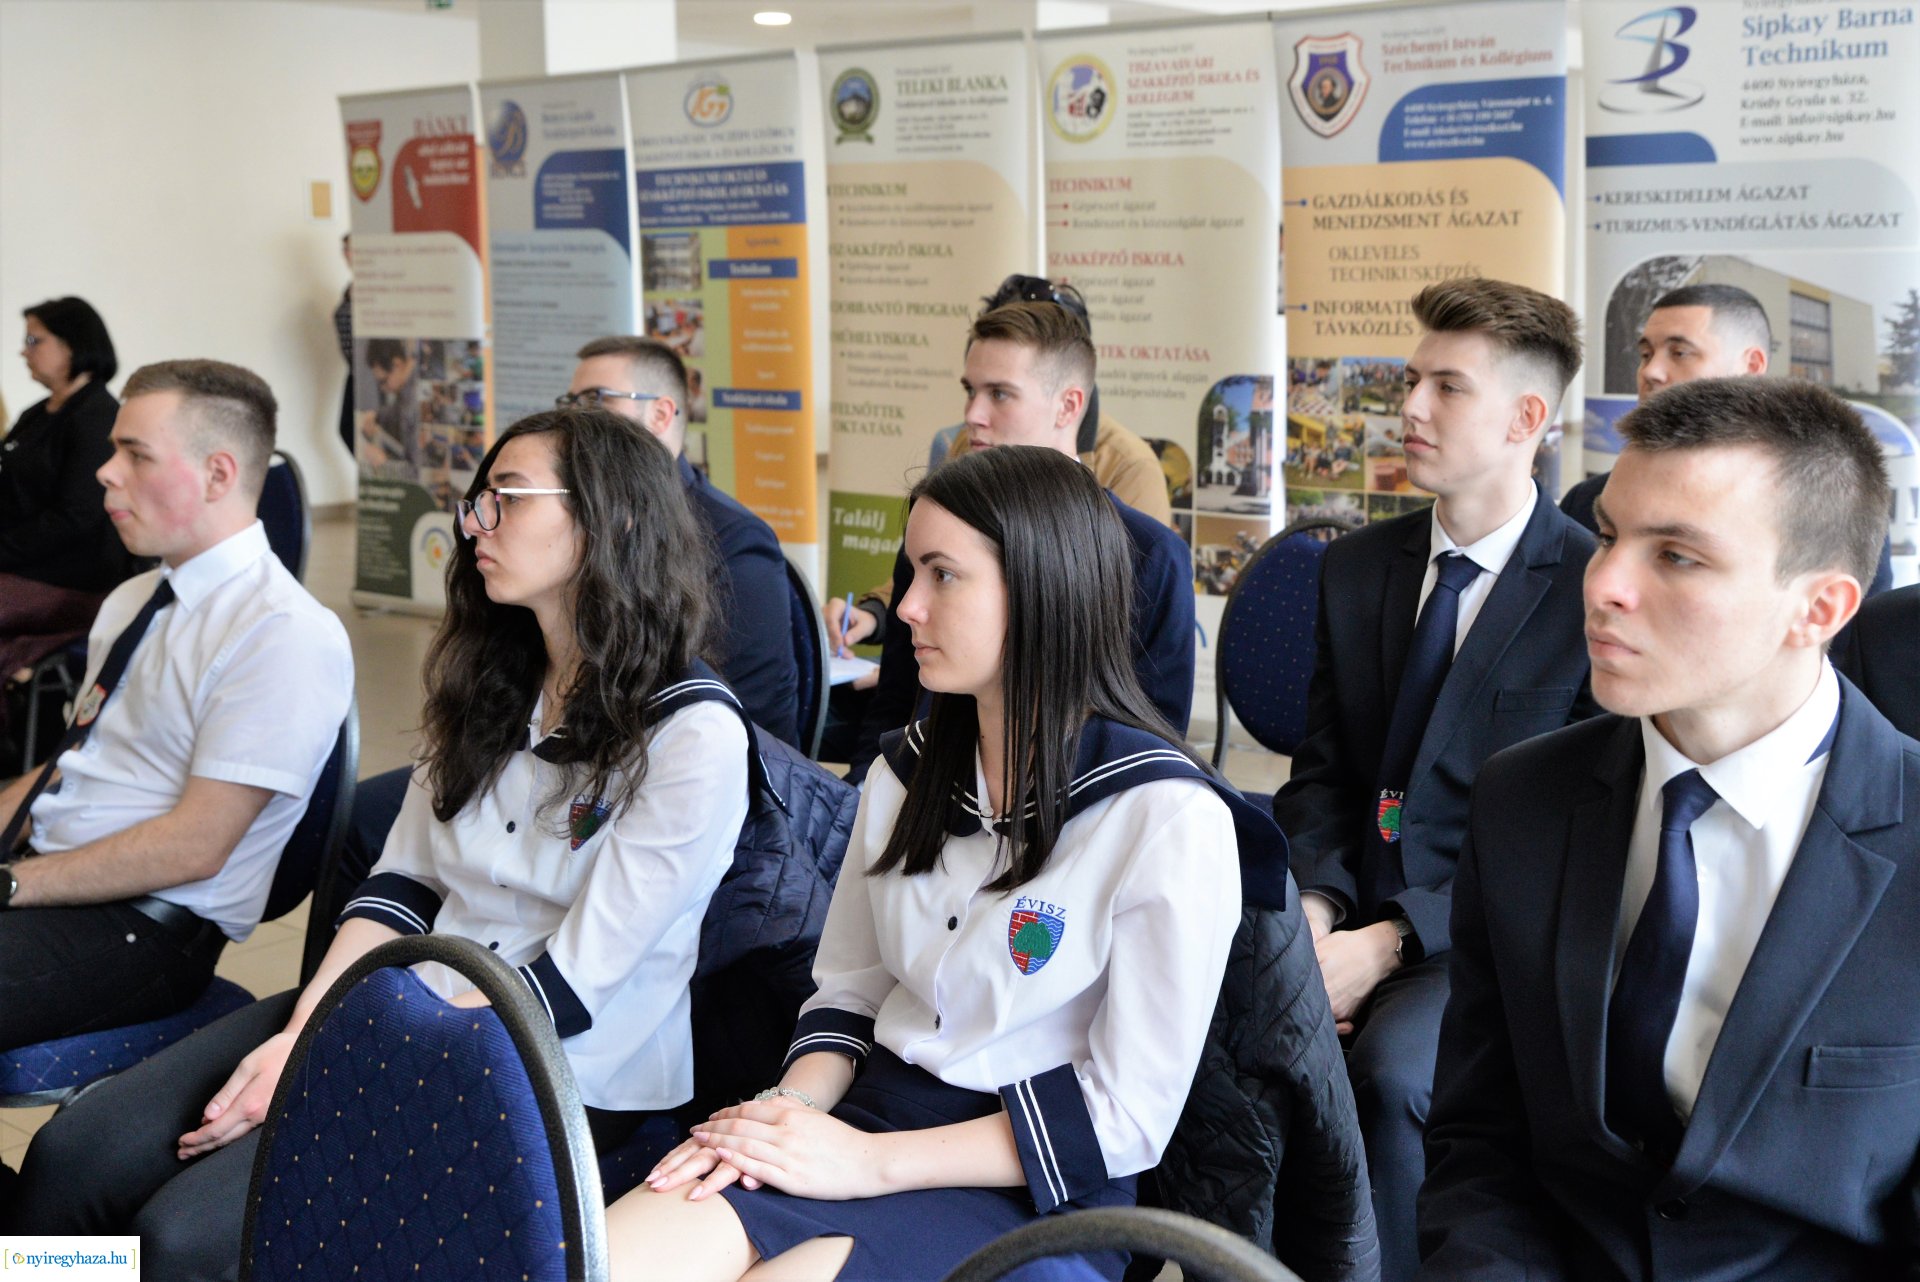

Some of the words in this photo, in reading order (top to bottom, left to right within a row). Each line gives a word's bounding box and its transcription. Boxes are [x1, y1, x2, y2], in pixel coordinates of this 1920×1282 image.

[1742, 12, 1828, 40] Sipkay
[1838, 7, 1913, 31] Barna
[1741, 38, 1888, 67] Technikum
[1313, 190, 1445, 210] GAZDÁLKODÁS
[1450, 188, 1469, 206] ÉS
[1604, 187, 1732, 206] KERESKEDELEM
[1736, 184, 1811, 202] ÁGAZAT
[1312, 212, 1441, 231] MENEDZSMENT
[1446, 208, 1523, 228] ÁGAZAT
[1604, 213, 1818, 234] TURIZMUS-VENDÉGLÁTÁS
[1822, 210, 1903, 229] ÁGAZAT
[1131, 252, 1186, 268] ISKOLA
[1329, 244, 1421, 263] OKLEVELES
[1312, 299, 1414, 316] INFORMATI
[1313, 316, 1415, 337] TÁVKÖZLÉS
[832, 506, 888, 531] Találj
[1014, 895, 1067, 920] ÉVISZ
